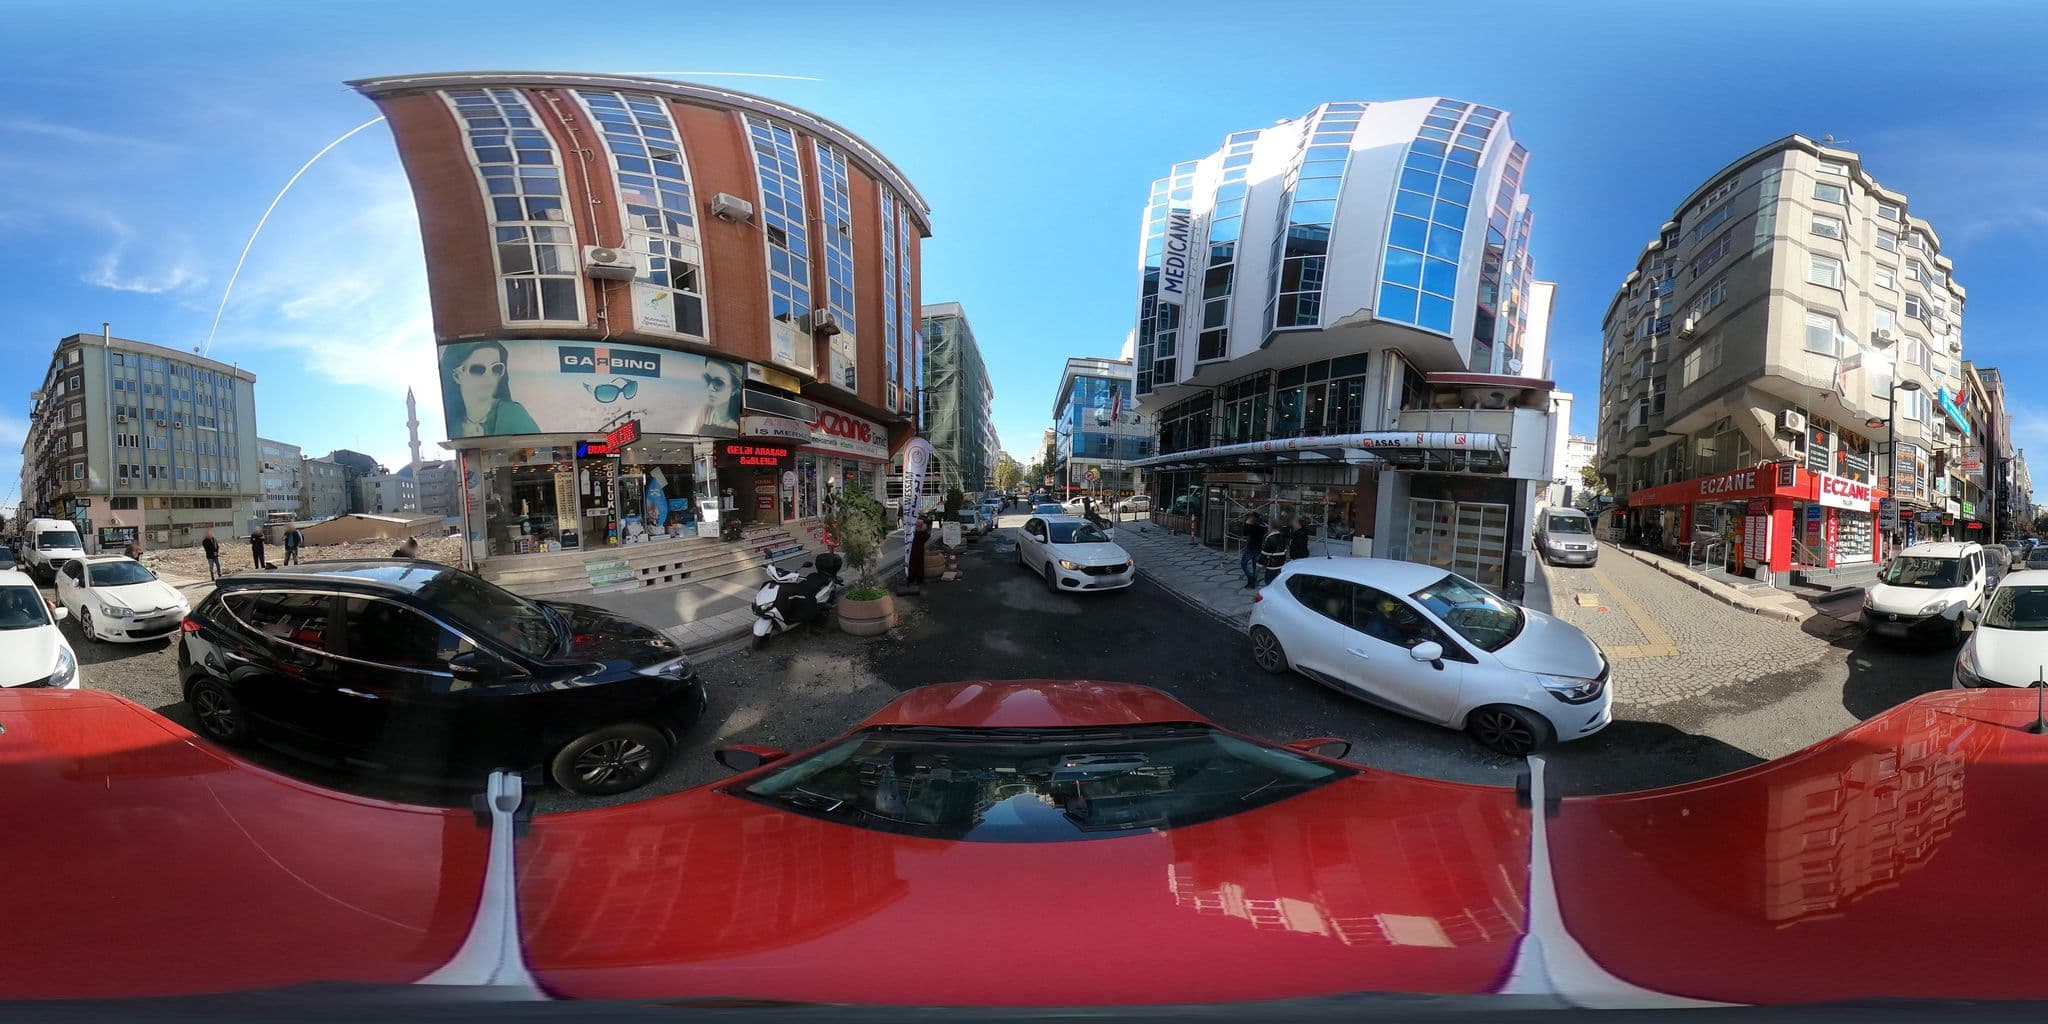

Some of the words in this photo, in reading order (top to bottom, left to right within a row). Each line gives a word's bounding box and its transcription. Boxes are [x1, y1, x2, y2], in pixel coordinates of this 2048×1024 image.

[1164, 213, 1190, 294] MEDICANA
[564, 355, 657, 371] GARBINO
[1375, 439, 1401, 448] ASAS
[1701, 472, 1756, 495] ECZANE
[1823, 476, 1870, 501] ECZANE
[1829, 508, 1837, 560] ECZANE
